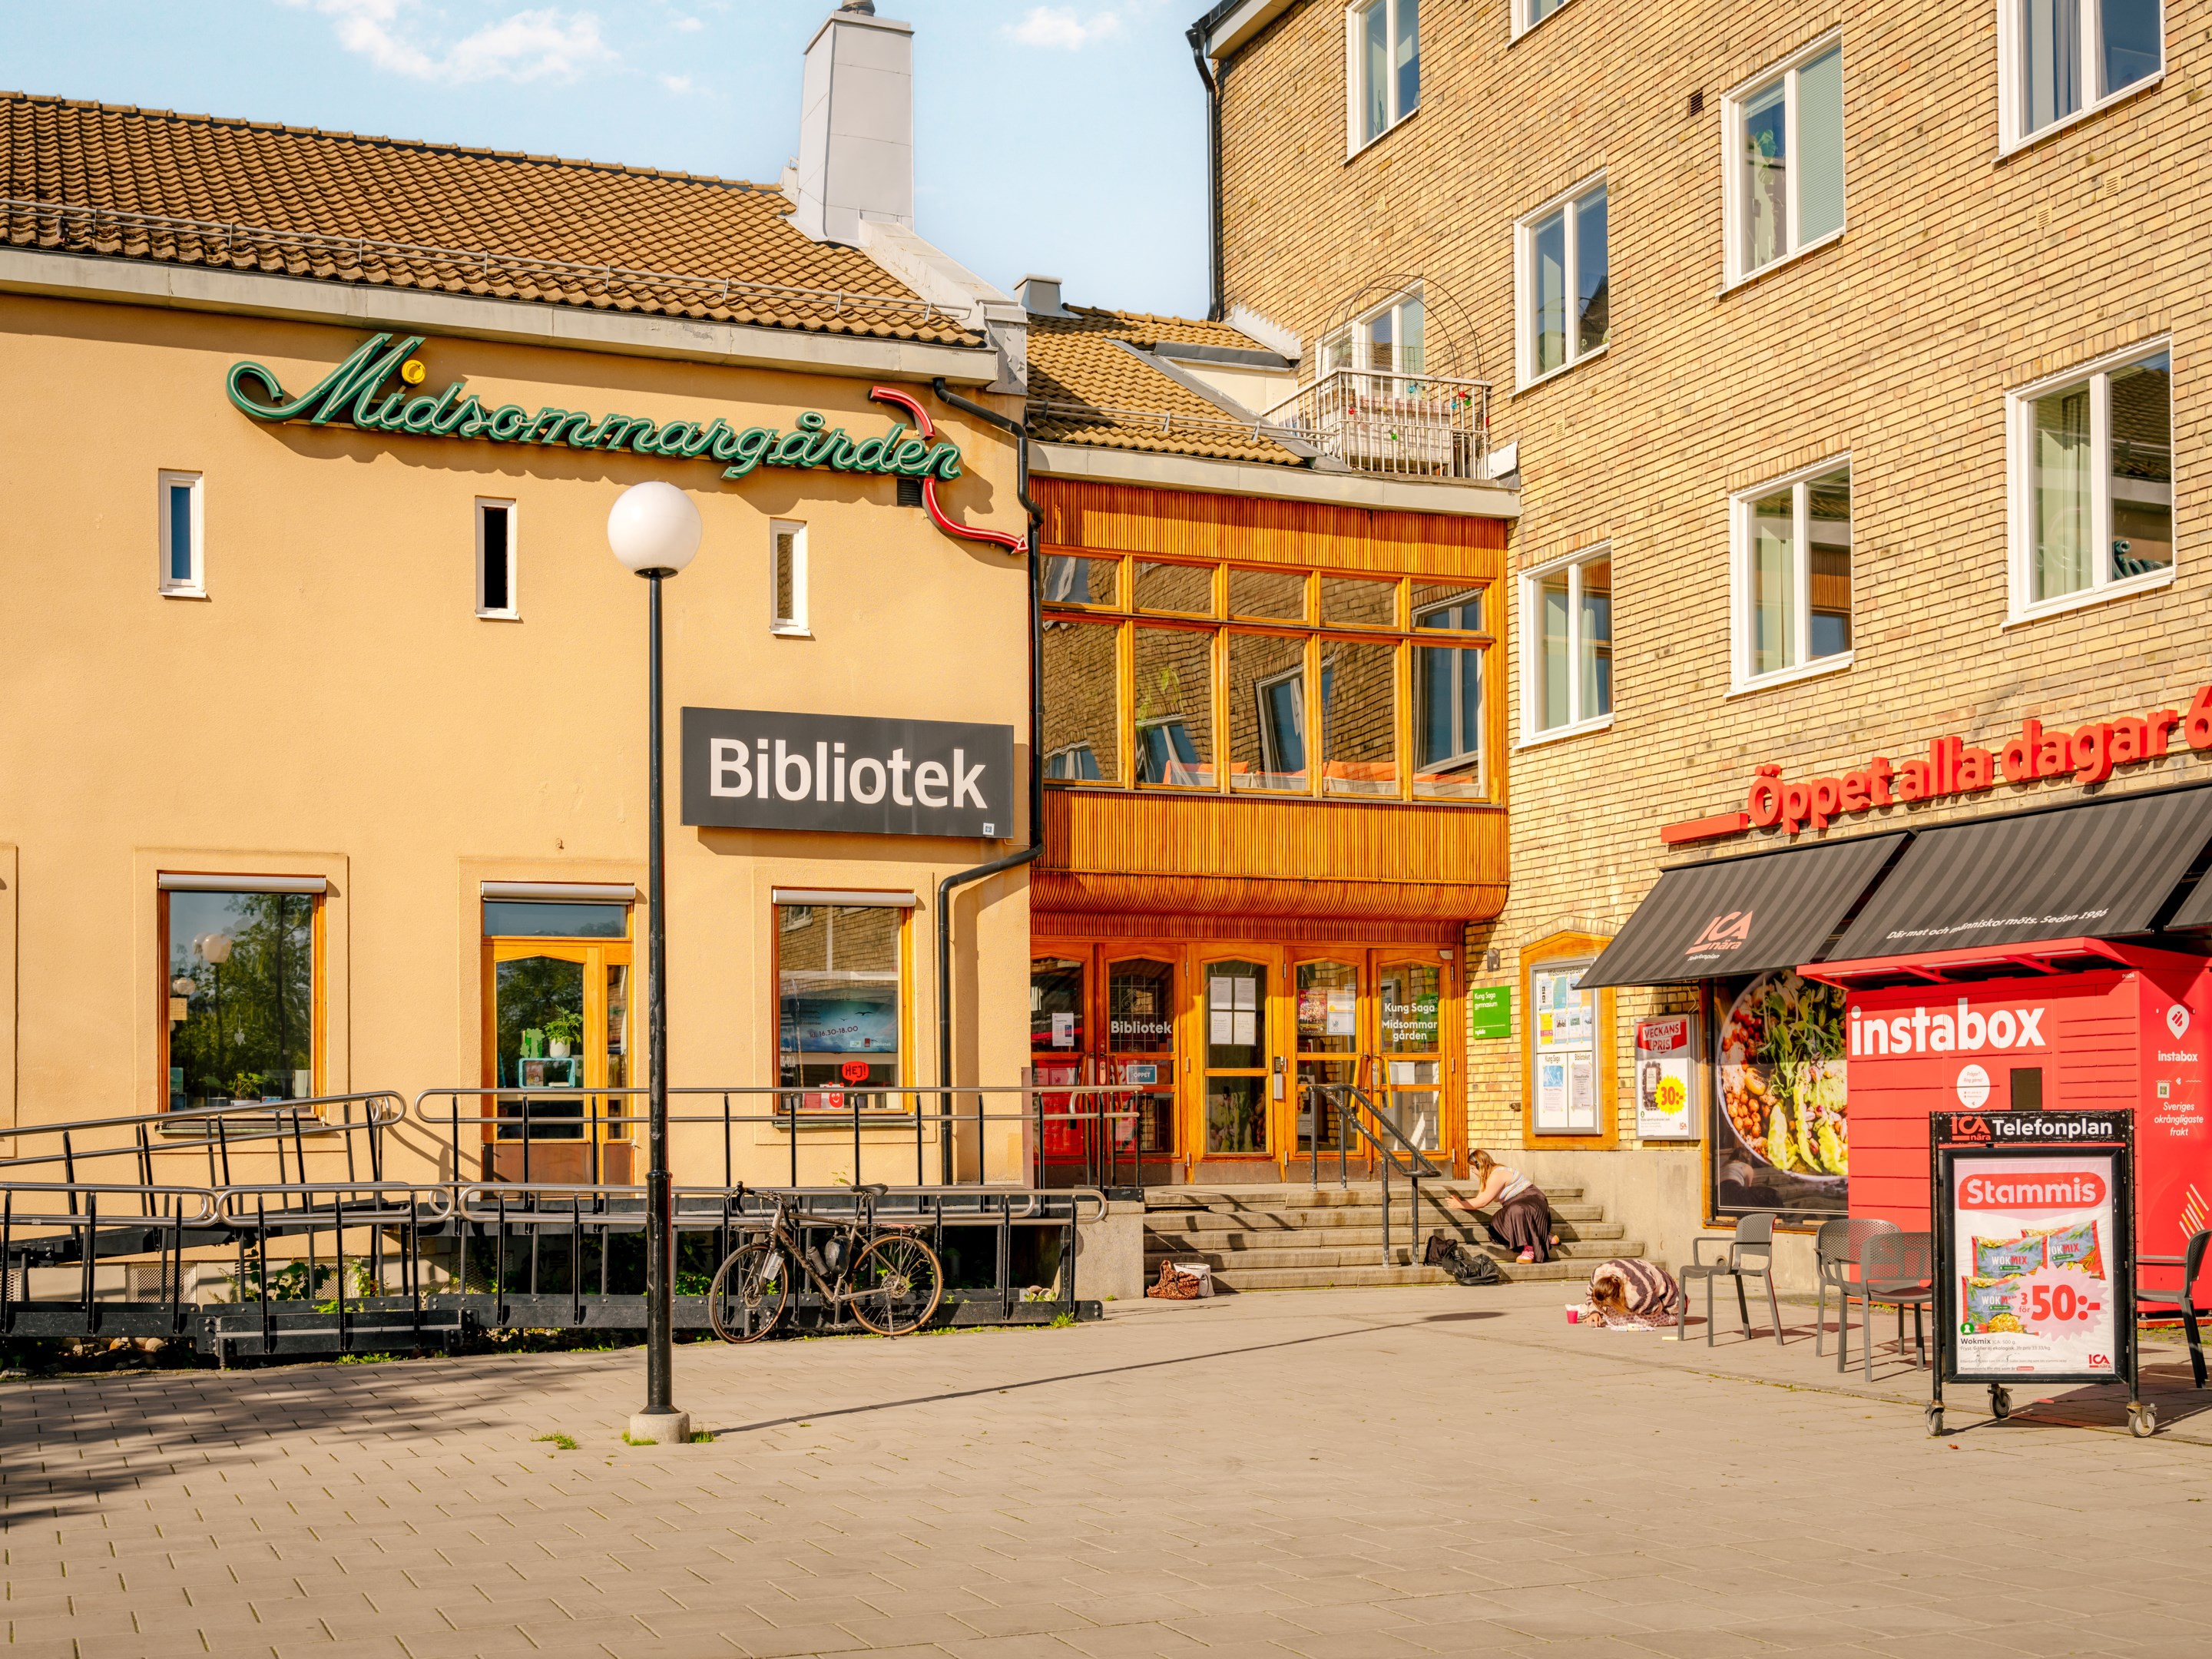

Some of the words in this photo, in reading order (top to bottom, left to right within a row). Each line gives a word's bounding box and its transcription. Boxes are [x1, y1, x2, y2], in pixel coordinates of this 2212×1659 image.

[227, 333, 962, 481] Midsommargården
[710, 737, 988, 810] Bibliotek
[1747, 757, 1894, 834] Öppet
[1899, 736, 1993, 801] alla
[2000, 709, 2178, 783] dagar
[1694, 910, 1753, 945] ICA
[1886, 930, 1907, 939] Där
[1906, 929, 1929, 937] mat
[1929, 927, 1949, 935] och
[1949, 919, 2007, 934] människor
[2006, 916, 2038, 926] möts.
[2040, 914, 2078, 924] Sedan
[2078, 909, 2109, 920] 1986
[1708, 939, 1742, 950] nära
[1475, 992, 1485, 1001] Kung
[1485, 992, 1496, 1000] Saga
[1384, 1003, 1409, 1014] Kung
[1411, 1002, 1435, 1014] Saga
[1475, 1001, 1498, 1011] gymnasium
[1111, 1021, 1172, 1034] Bibliotek
[1382, 1019, 1438, 1028] Midsommar
[1850, 998, 2046, 1056] instabox
[819, 1025, 859, 1036] 16.30-18.00
[1392, 1029, 1427, 1042] gården
[1644, 1024, 1679, 1038] VECKANS
[1652, 1038, 1671, 1051] PRIS
[2157, 1050, 2198, 1062] instabox
[845, 1065, 866, 1078] HEJ!
[1661, 1086, 1684, 1106] 30:-
[2163, 1101, 2195, 1112] Sveriges
[1951, 1115, 1991, 1134] ICA
[1992, 1118, 2112, 1138] Telefonplan
[2154, 1114, 2204, 1126] okrångligaste
[2170, 1128, 2189, 1136] frakt
[1967, 1177, 2097, 1204] Stammis
[2049, 1243, 2080, 1255] OKMIX
[1992, 1256, 2028, 1266] WOKMIX
[2021, 1292, 2028, 1305] 3
[2031, 1284, 2101, 1321] 50:-
[2089, 1354, 2111, 1364] ICA
